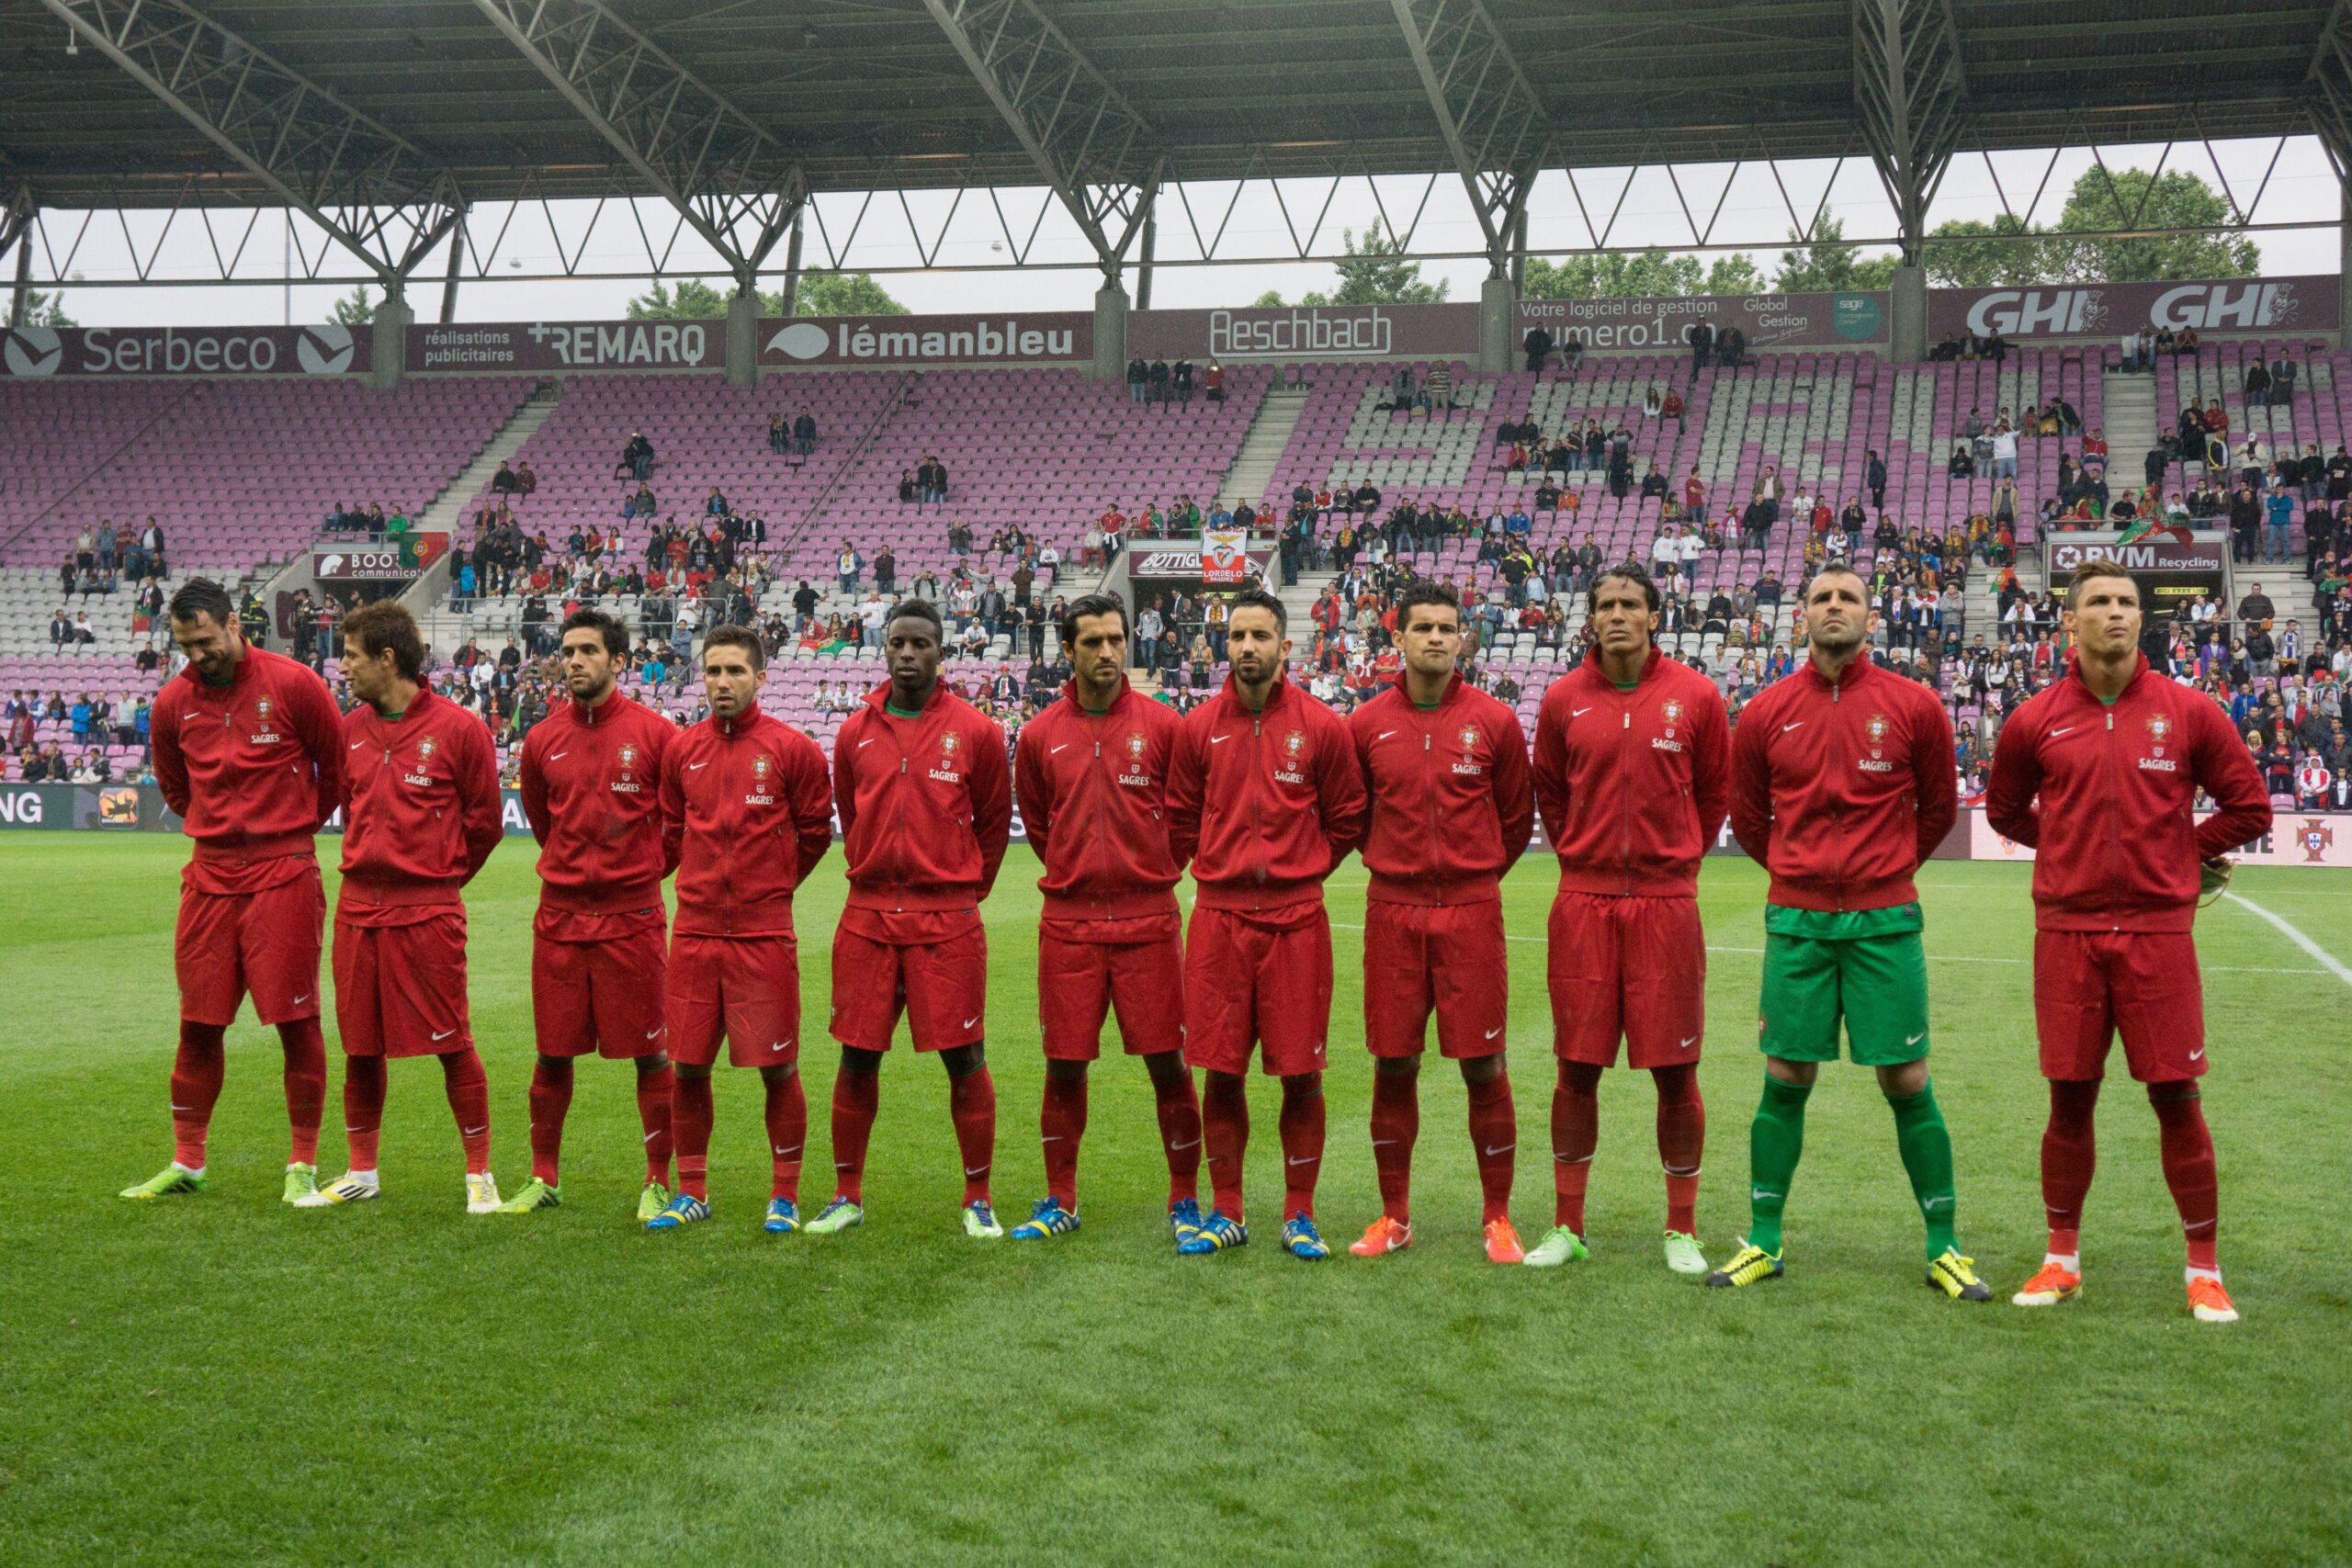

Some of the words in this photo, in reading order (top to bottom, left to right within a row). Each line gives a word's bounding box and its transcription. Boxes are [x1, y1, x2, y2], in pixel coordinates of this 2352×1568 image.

[1521, 302, 1565, 316] Votre
[1570, 299, 1626, 320] logiciel
[1632, 299, 1653, 314] de
[1657, 298, 1717, 317] gestion
[1743, 296, 1788, 311] Global
[1839, 299, 1863, 310] sage
[2150, 283, 2280, 333] GHI
[1758, 313, 1808, 327] Gestion
[1966, 290, 2089, 338] GHI
[425, 330, 509, 344] réalisations
[1210, 307, 1392, 354] Aeschbach
[839, 321, 1073, 357] lémanbleu
[83, 327, 277, 371] Serbeco
[425, 348, 514, 367] publicitaires
[1142, 552, 1204, 568] BOTTIGL
[2159, 558, 2219, 569] Recycling
[352, 568, 422, 577] communica
[1204, 570, 1243, 578] LORDELO
[251, 734, 280, 744] SAGRES
[1652, 738, 1682, 752] SAGRES
[1452, 762, 1481, 775] SAGRES
[1859, 759, 1893, 772] SAGRES
[2139, 758, 2177, 772] SAGRES
[404, 773, 432, 786] SAGRES
[929, 768, 959, 782] SAGRES
[1118, 773, 1149, 786] SAGRES
[1274, 770, 1304, 784] SAGRES
[611, 782, 639, 793] SAGRES
[745, 795, 774, 805] SAGRES
